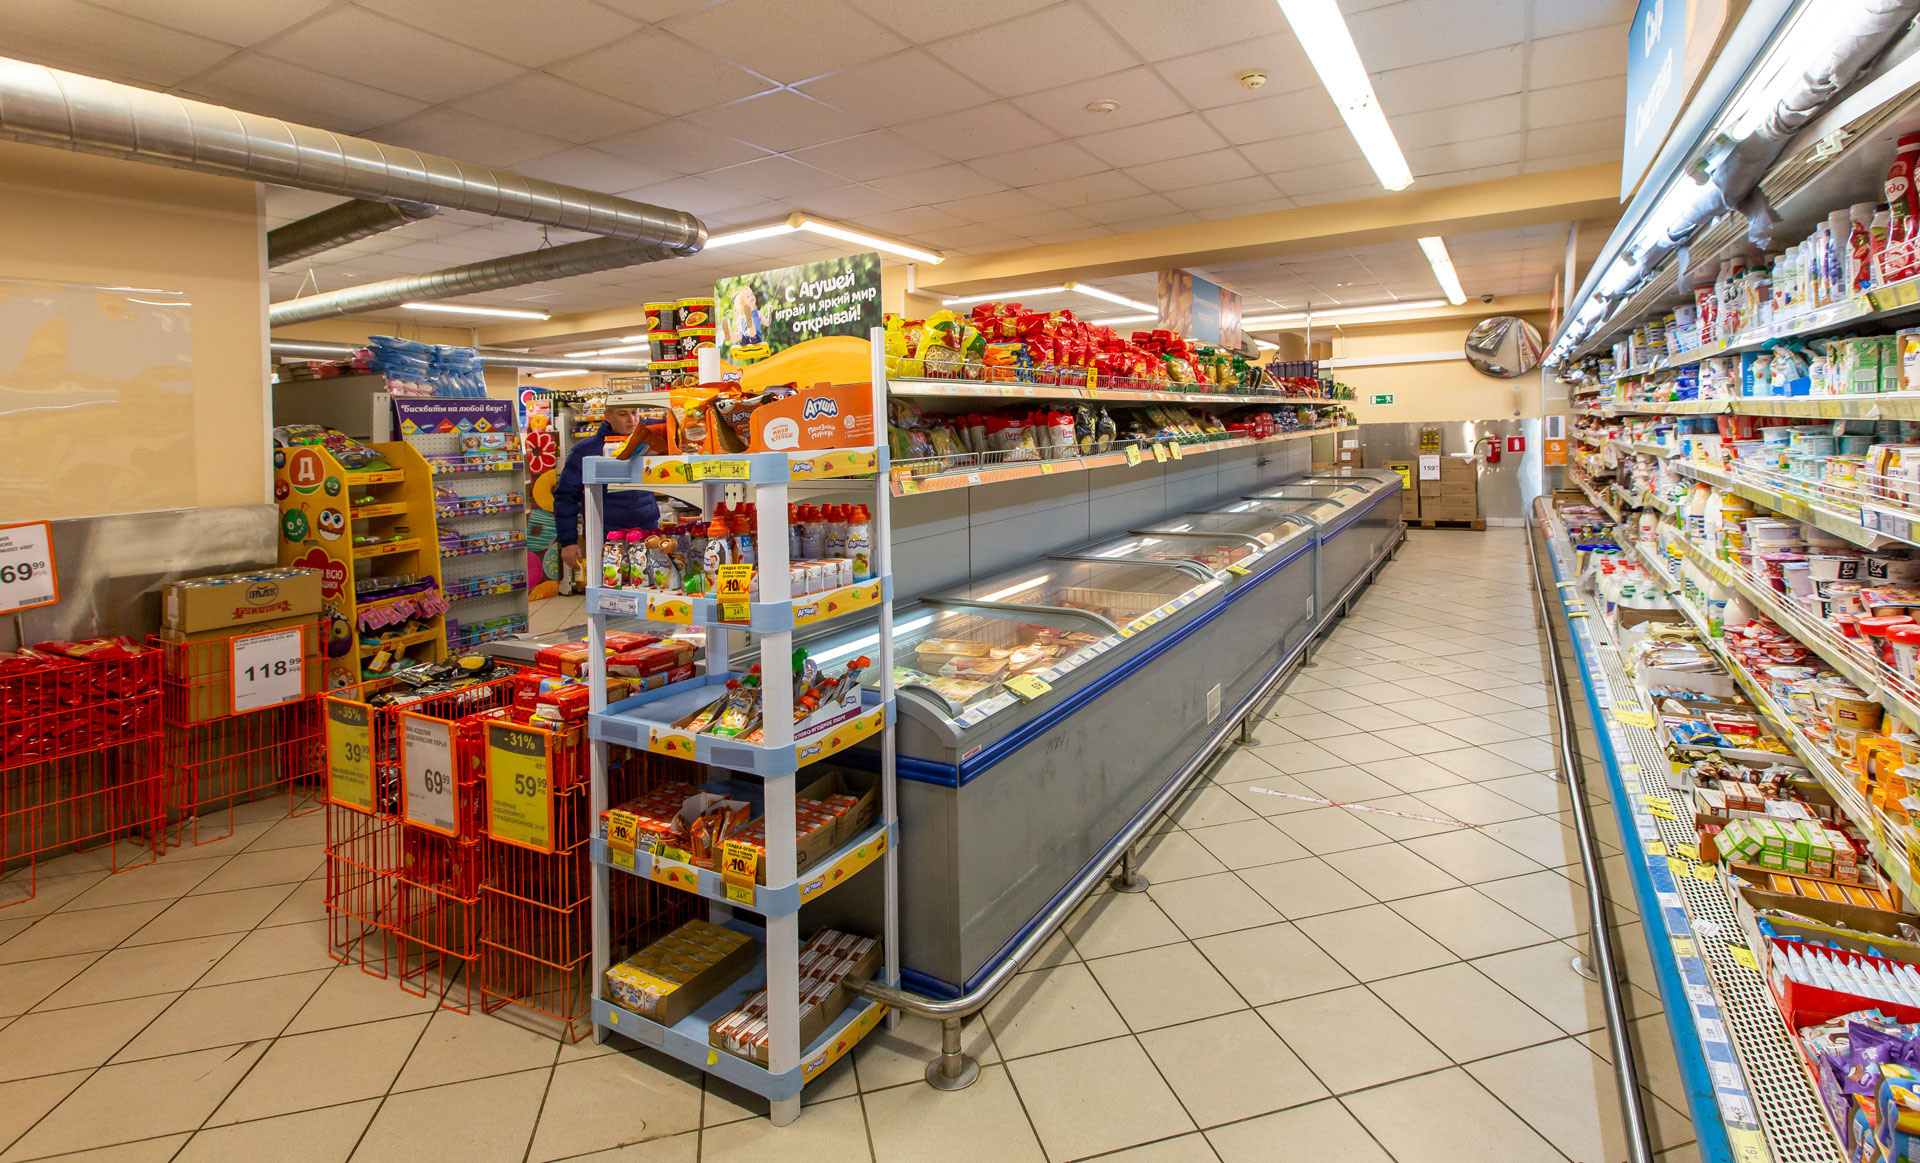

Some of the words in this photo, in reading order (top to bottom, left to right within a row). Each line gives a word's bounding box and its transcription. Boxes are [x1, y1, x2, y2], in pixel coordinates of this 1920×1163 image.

[785, 285, 796, 302] С
[799, 268, 855, 300] Агушей
[775, 302, 805, 321] играй
[809, 302, 816, 312] и
[818, 291, 851, 312] яркий
[851, 286, 877, 302] мир
[792, 303, 861, 333] открывай!
[401, 405, 447, 413] Бисквиты
[485, 405, 507, 414] вкус!
[804, 397, 838, 420] АГУША
[298, 457, 316, 482] Д
[32, 561, 45, 570] 99
[244, 660, 287, 682] 118
[289, 657, 301, 666] 99
[338, 705, 361, 722] -35%
[345, 742, 361, 763] 39
[503, 732, 536, 751] -31%
[424, 768, 443, 795] 69
[514, 773, 537, 798] 59
[537, 776, 547, 789] 99
